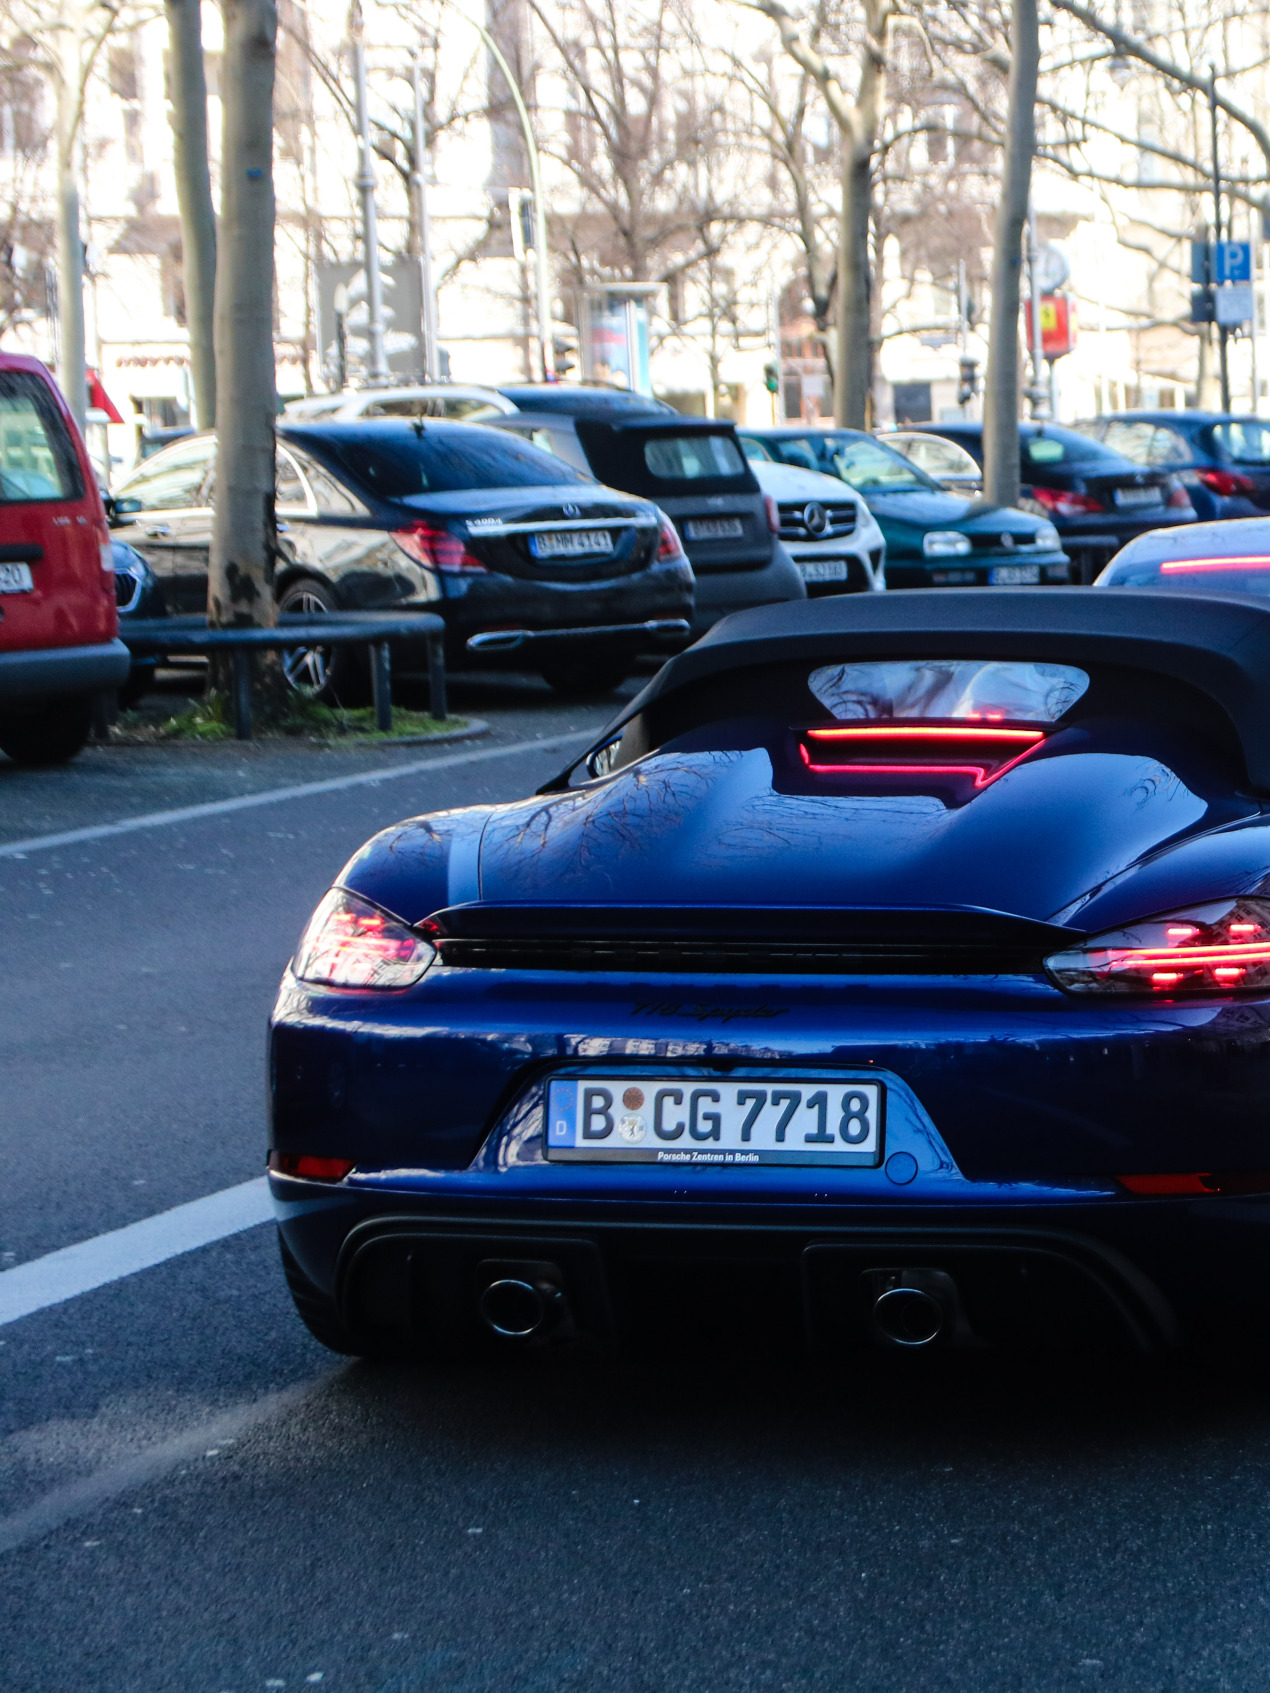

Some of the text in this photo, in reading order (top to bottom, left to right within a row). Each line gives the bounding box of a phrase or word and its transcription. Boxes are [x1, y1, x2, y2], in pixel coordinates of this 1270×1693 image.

[582, 1087, 870, 1144] B CG 7718
[555, 1120, 567, 1135] D
[657, 1151, 760, 1162] Porsche Zentren in Berlin
